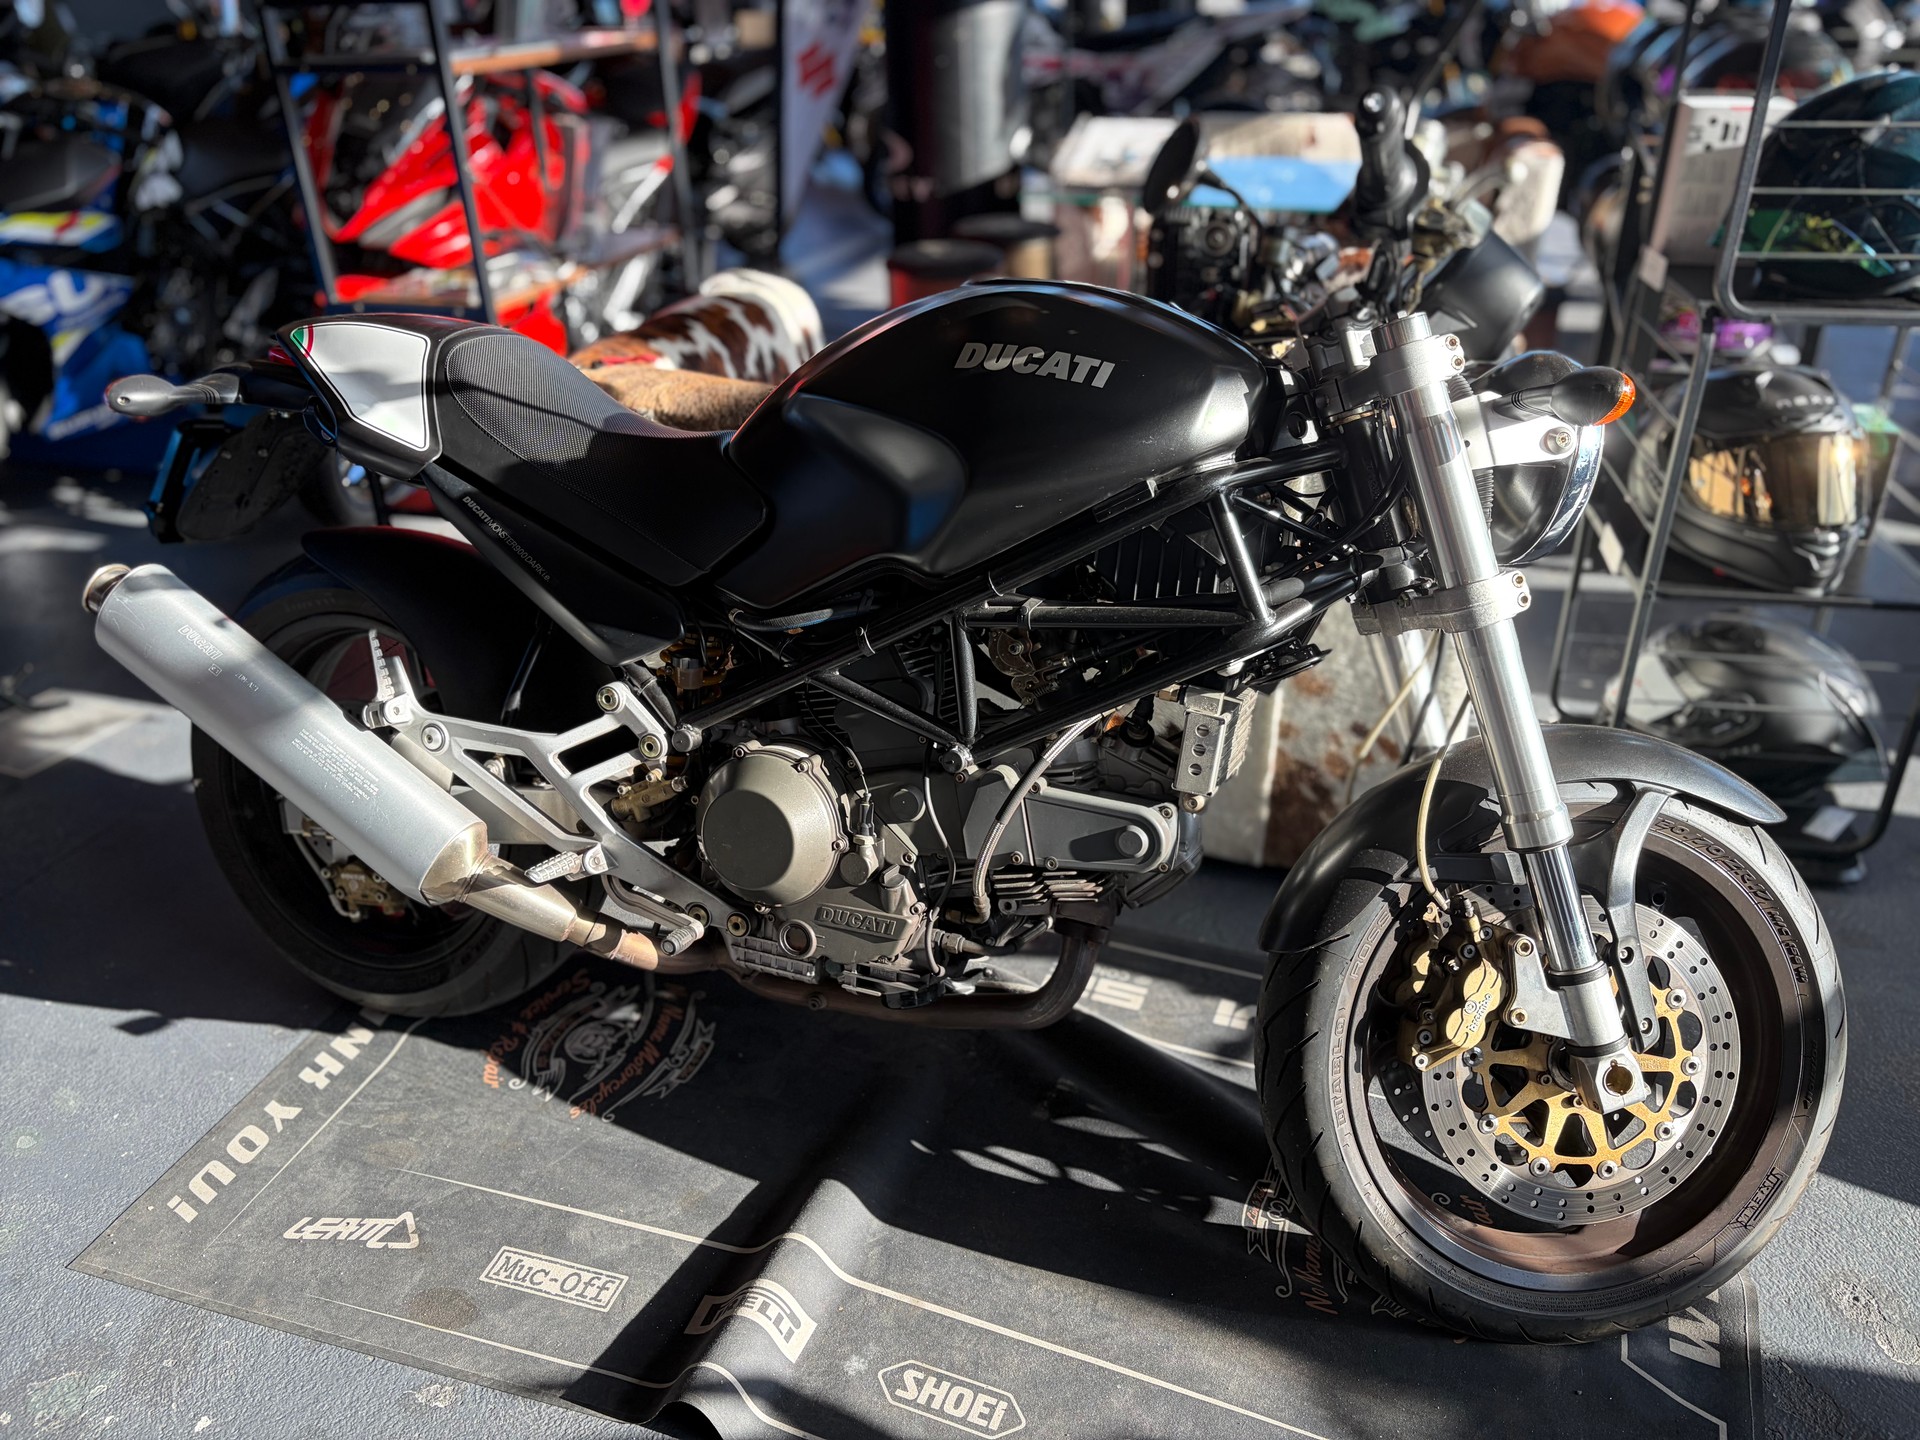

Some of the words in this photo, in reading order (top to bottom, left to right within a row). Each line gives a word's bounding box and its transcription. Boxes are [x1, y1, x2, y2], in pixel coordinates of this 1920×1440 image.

[954, 342, 1116, 389] DUCATI
[177, 624, 223, 660] DUCATI
[821, 906, 897, 936] DUCATI
[1331, 1017, 1346, 1128] DIABLO
[1350, 911, 1391, 979] ROSS
[166, 1099, 303, 1224] YOU!
[283, 1211, 419, 1249] LEATT
[1459, 1193, 1495, 1225] air
[492, 1254, 615, 1303] Muc-Off
[895, 1369, 1008, 1431] SHOEI
